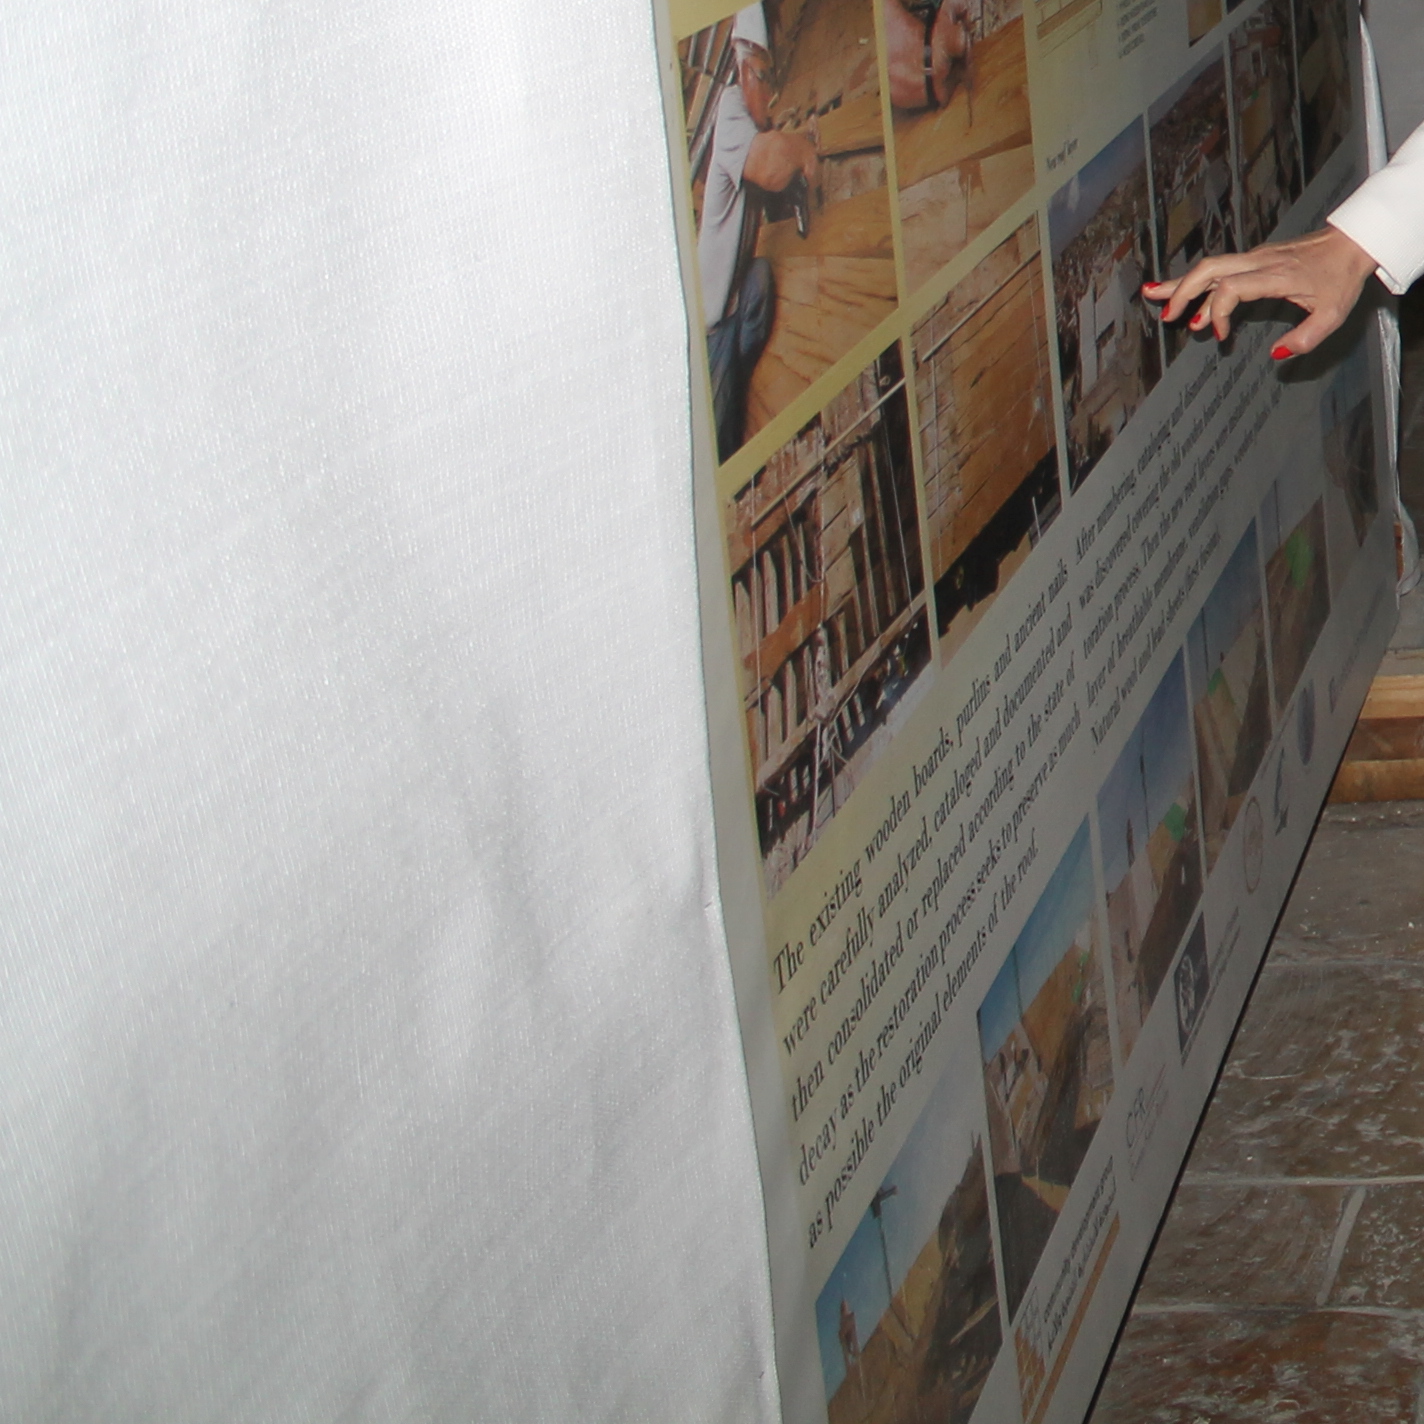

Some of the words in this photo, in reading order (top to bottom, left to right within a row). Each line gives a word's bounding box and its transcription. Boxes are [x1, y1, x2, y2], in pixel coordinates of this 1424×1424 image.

[1076, 524, 1096, 566] After
[773, 941, 804, 994] The
[809, 859, 863, 947] existing
[864, 790, 911, 864] wooden
[956, 674, 991, 748] purlins
[993, 633, 1012, 683] and
[1014, 591, 1047, 653] ancient
[1047, 558, 1068, 604] nails
[782, 996, 817, 1056] were
[820, 906, 875, 1005] carefully
[933, 736, 982, 833] cataloged
[983, 706, 1002, 759] and
[1002, 626, 1056, 728] documented
[1056, 601, 1073, 648] and
[791, 1060, 825, 1123] then
[827, 920, 904, 1065] consolidated
[906, 907, 919, 941] or
[921, 823, 966, 918] replaced
[968, 758, 1015, 843] according
[1014, 740, 1026, 768] to
[1027, 713, 1042, 748] the
[1044, 679, 1064, 723] state
[1065, 649, 1076, 687] of
[798, 1108, 837, 1186] decay
[840, 1083, 854, 1121] as
[854, 1047, 876, 1093] the
[876, 944, 939, 1059] restoration
[938, 881, 976, 967] process
[976, 838, 1002, 893] seeks
[1000, 822, 1013, 850] to
[1012, 762, 1048, 844] preserve
[1048, 745, 1058, 773] as
[1057, 701, 1081, 757] much
[808, 1210, 823, 1250] as
[825, 1117, 874, 1232] possible
[876, 1081, 897, 1127] the
[899, 992, 942, 1088] original
[942, 925, 987, 1012] elements
[987, 891, 999, 934] of
[1000, 873, 1017, 911] the
